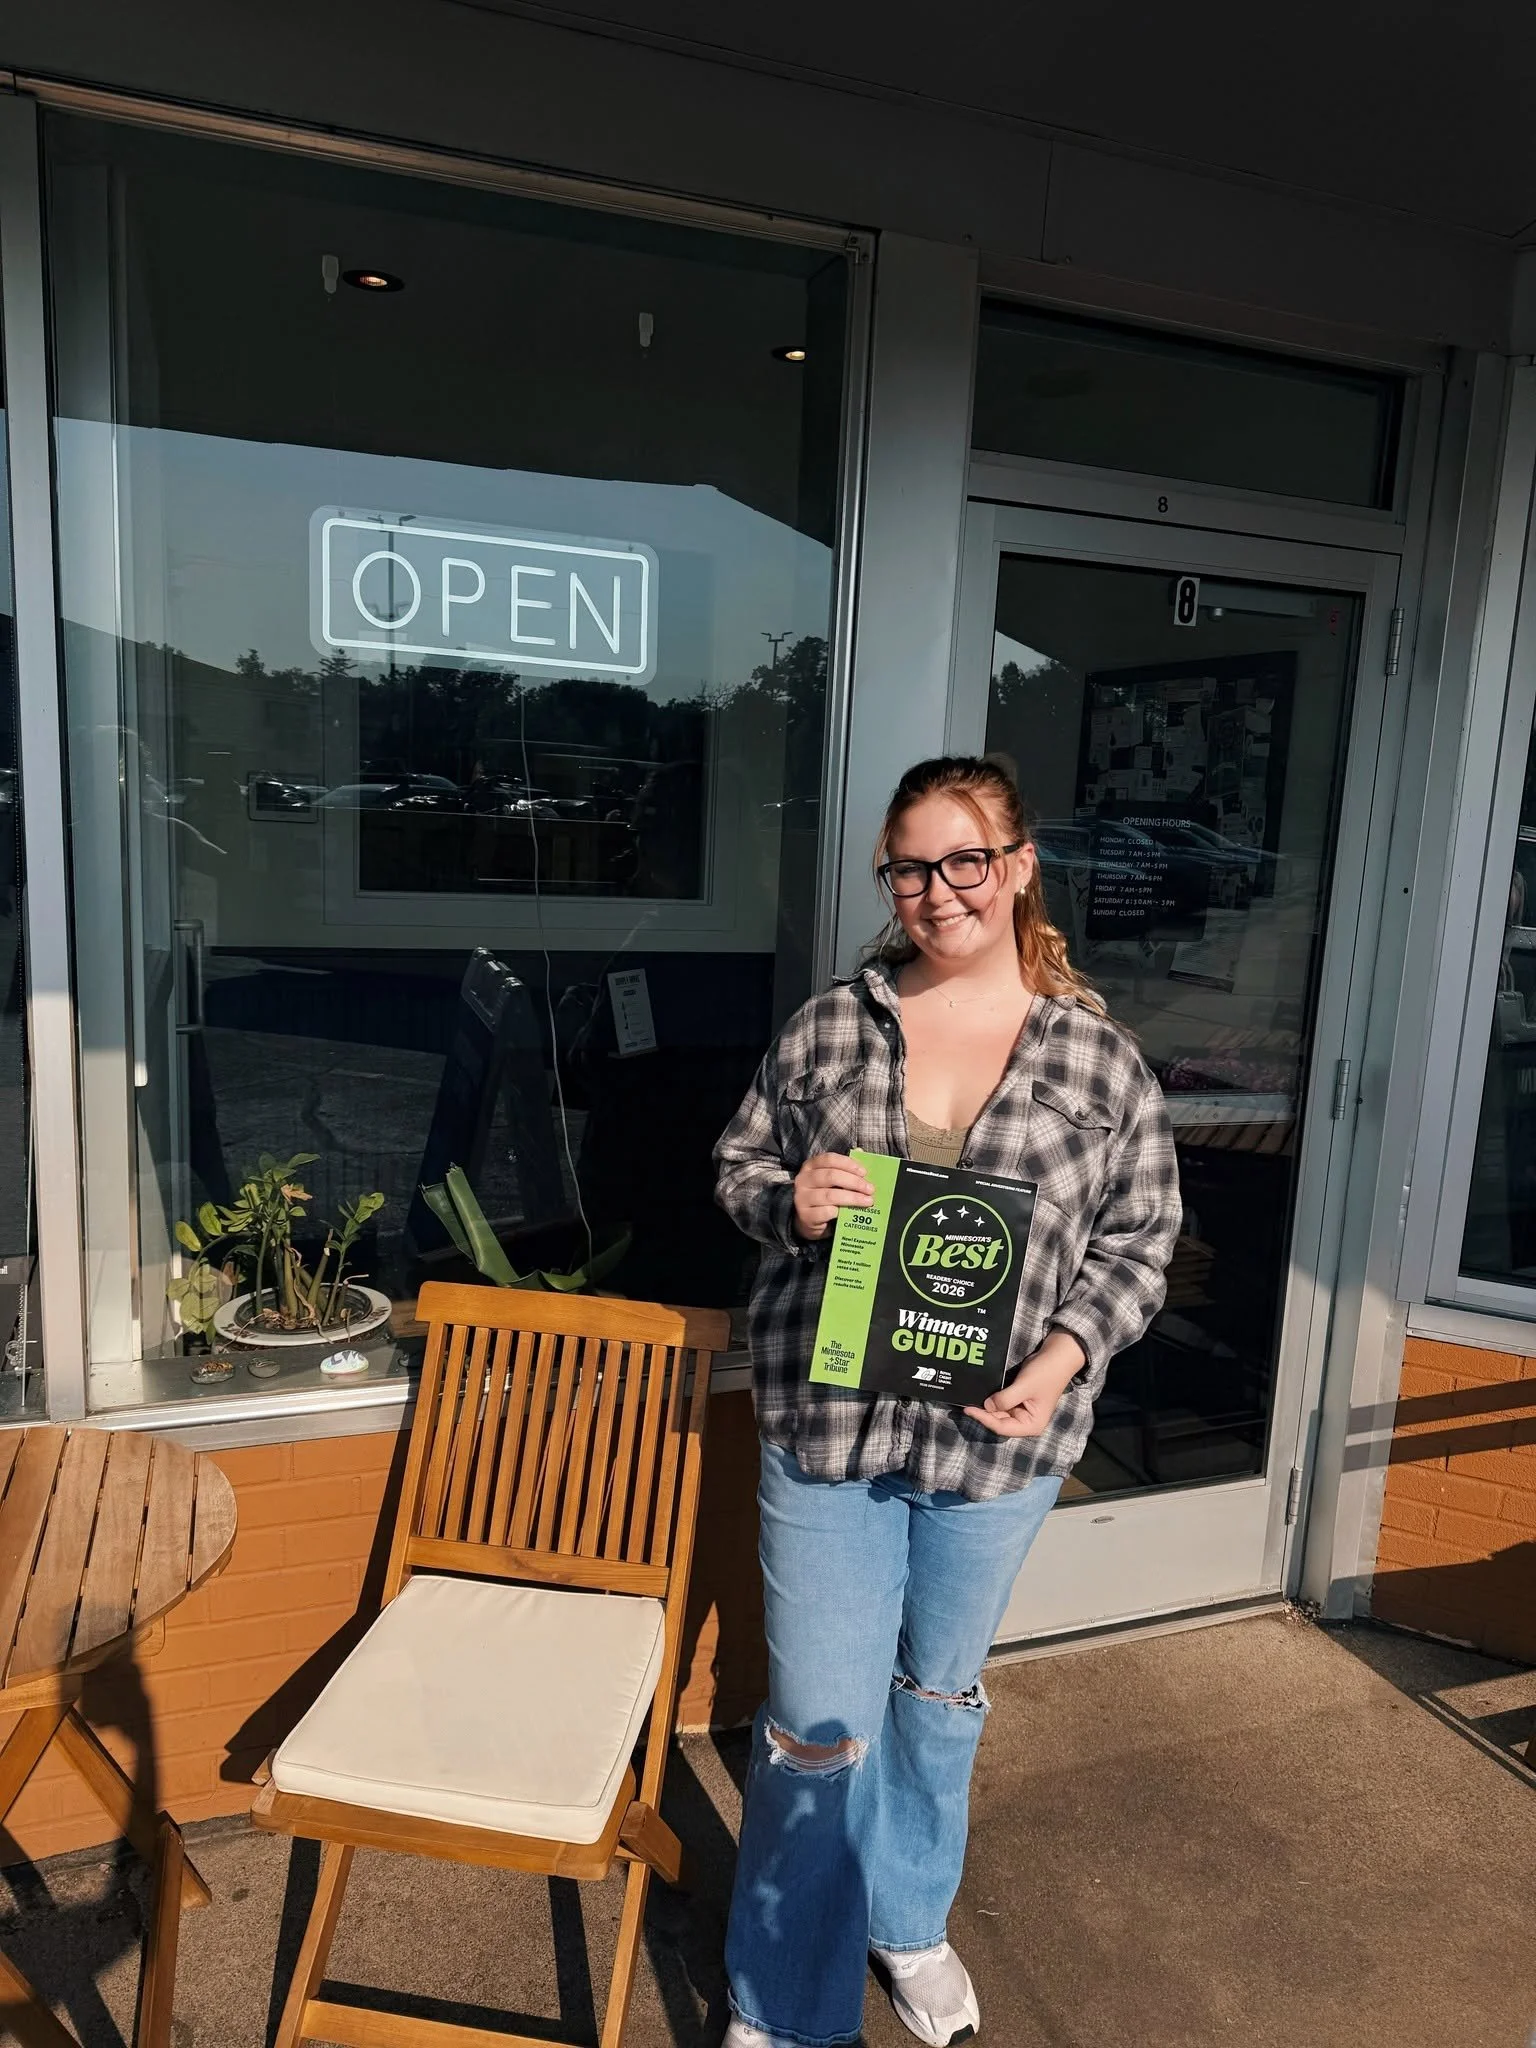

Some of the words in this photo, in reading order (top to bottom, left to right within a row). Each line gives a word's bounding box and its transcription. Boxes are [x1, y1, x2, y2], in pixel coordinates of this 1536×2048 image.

[1158, 496, 1168, 513] 8
[352, 550, 621, 654] OPEN
[1177, 579, 1196, 624] 8
[1122, 816, 1161, 826] OPENING
[1162, 817, 1191, 828] HOURS
[1092, 908, 1117, 916] SUNDAY
[1118, 909, 1145, 917] CLOSED
[852, 1214, 872, 1225] 390
[843, 1222, 878, 1232] CATEGORIES
[944, 1234, 992, 1243] MINNESOTA'S
[907, 1233, 1005, 1270] Best
[926, 1273, 952, 1283] READERS'
[952, 1278, 975, 1287] CHOICE
[931, 1282, 966, 1297] 2026
[898, 1308, 989, 1341] Winners
[831, 1340, 842, 1349] The
[891, 1328, 987, 1366] GUIDE
[821, 1346, 855, 1359] Minnesota
[824, 1362, 848, 1374] Tribune
[834, 1357, 850, 1366] Star
